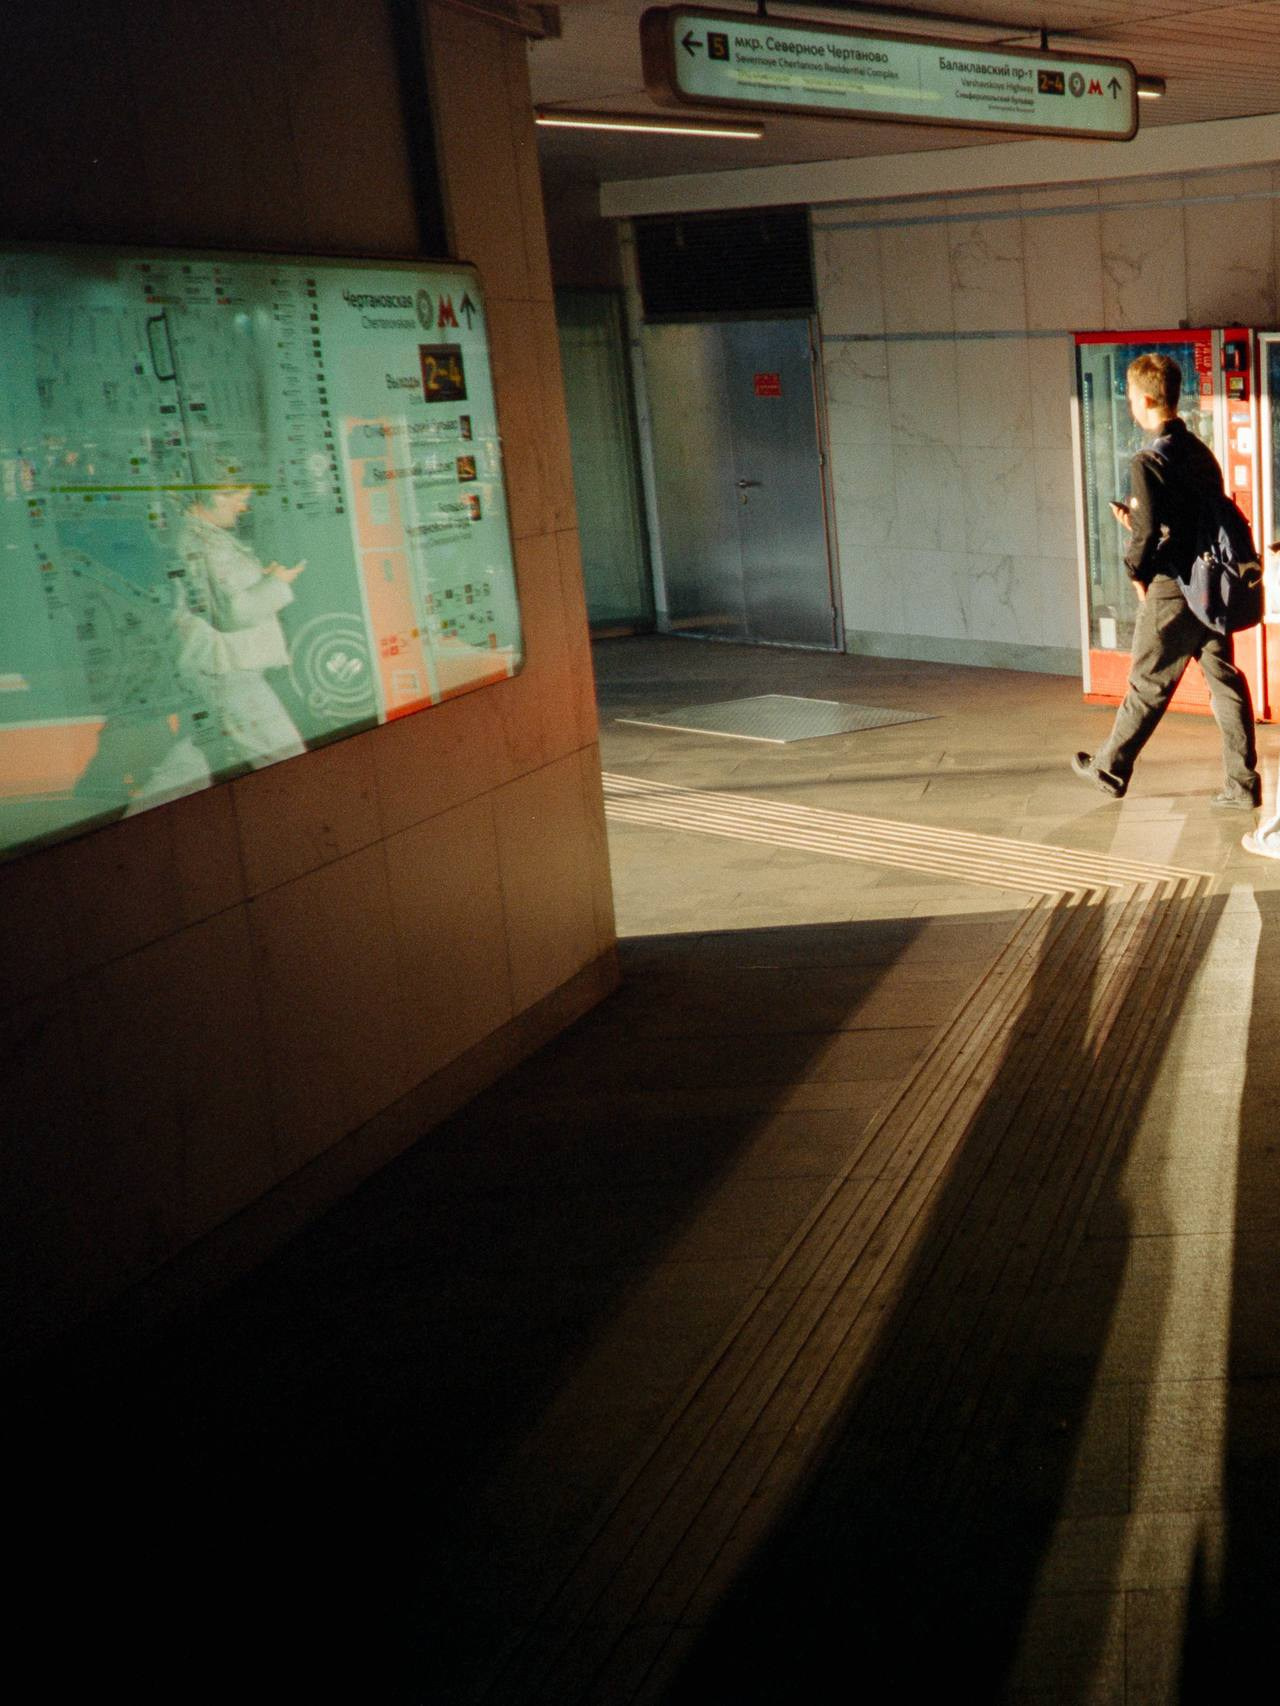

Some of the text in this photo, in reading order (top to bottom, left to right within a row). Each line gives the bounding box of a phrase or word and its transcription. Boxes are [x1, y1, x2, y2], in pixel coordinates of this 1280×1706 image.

[735, 36, 763, 51] мкр.
[766, 37, 825, 57] Северное
[827, 45, 888, 64] Чертаново
[939, 57, 1010, 76] Балаклавский
[1040, 74, 1063, 92] 2-4
[342, 289, 413, 310] Чертановская
